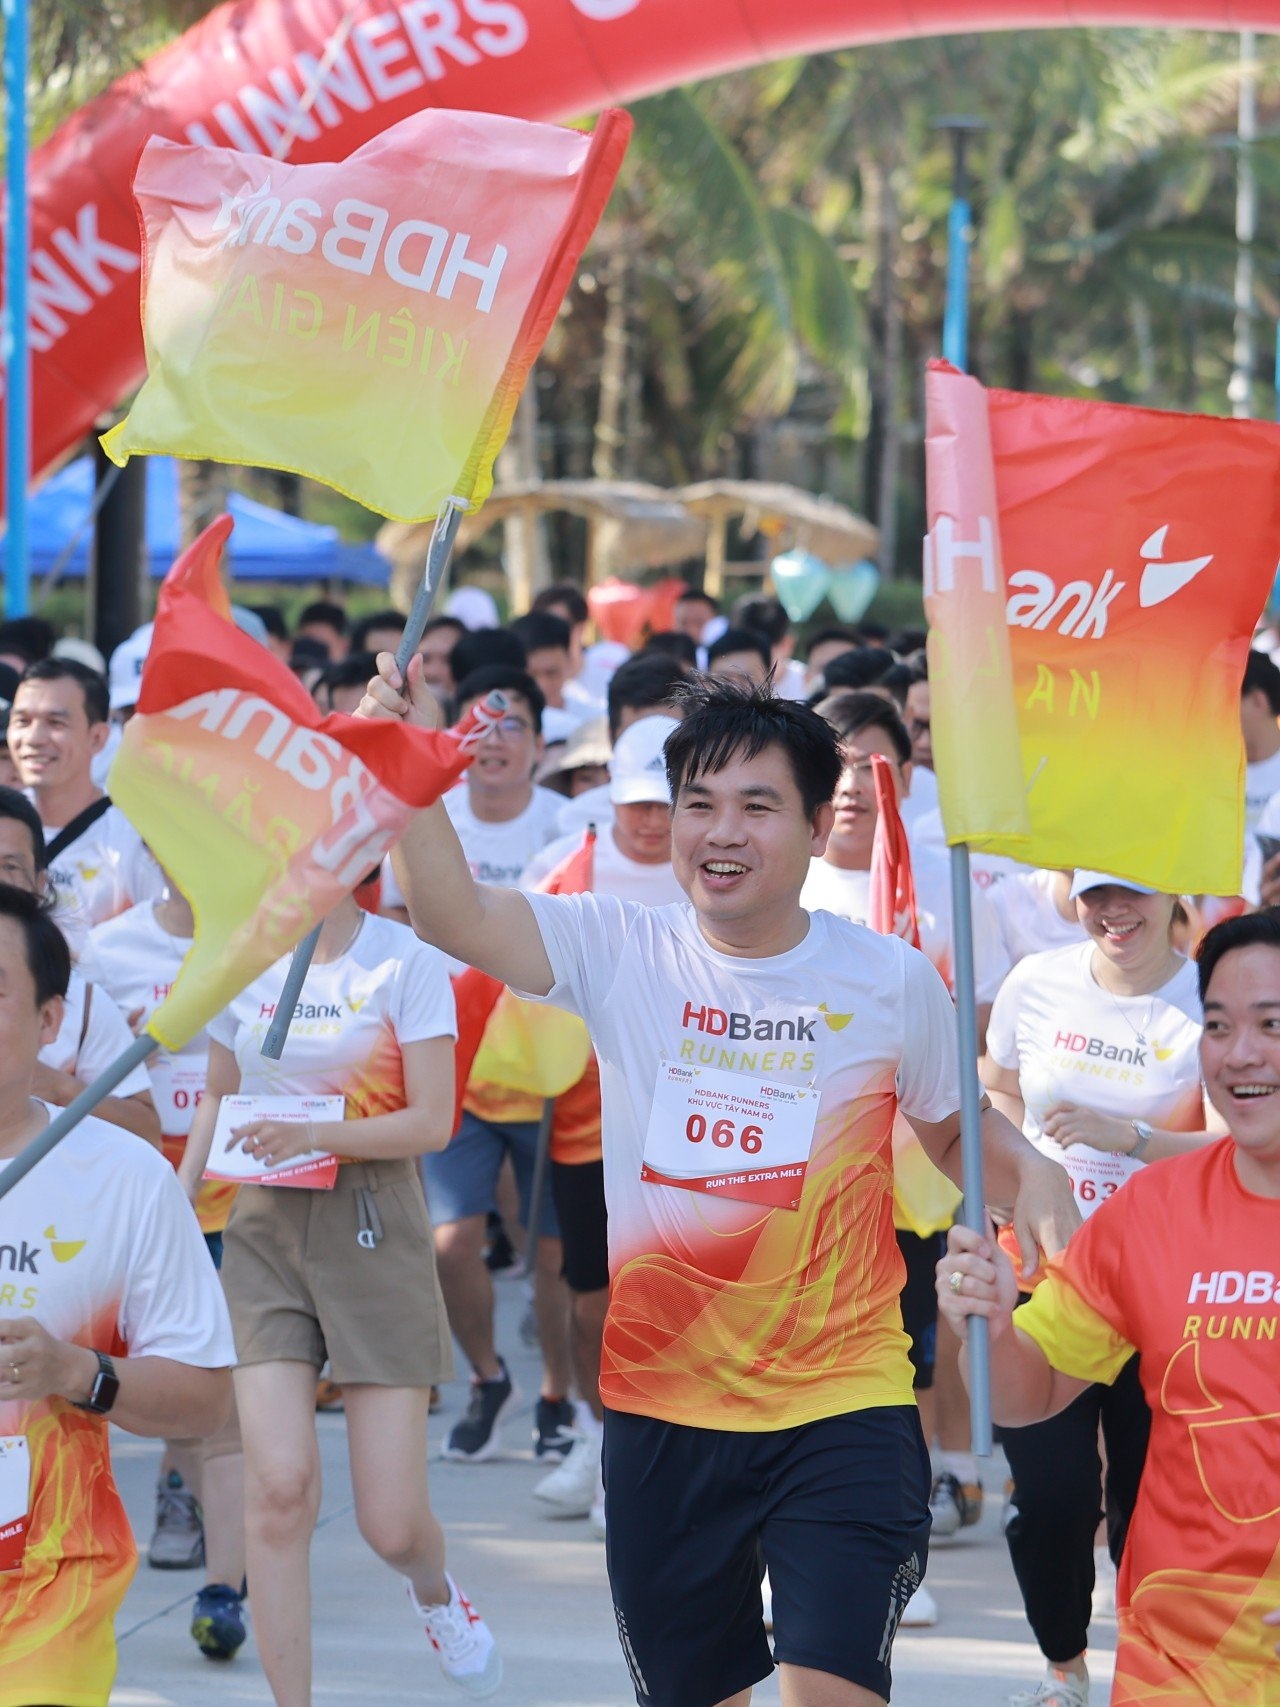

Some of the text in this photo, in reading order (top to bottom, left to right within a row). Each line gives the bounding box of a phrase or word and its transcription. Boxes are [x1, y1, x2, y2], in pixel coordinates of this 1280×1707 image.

[186, 0, 528, 162] UNNERS
[258, 1002, 342, 1019] HBank
[251, 1023, 341, 1035] RNERS
[682, 1001, 818, 1042] HDBank
[680, 1039, 816, 1072] RUNNERS
[1054, 1031, 1147, 1067] HDBank
[694, 1088, 730, 1101] HDBANK
[730, 1095, 770, 1110] RUNNERS
[760, 1086, 796, 1101] HDBank
[687, 1097, 704, 1106] KHU
[741, 1108, 760, 1118] NAM
[685, 1113, 764, 1155] 066
[705, 1168, 803, 1189] RUN THE EXTRA MILE
[0, 1523, 23, 1540] MILE
